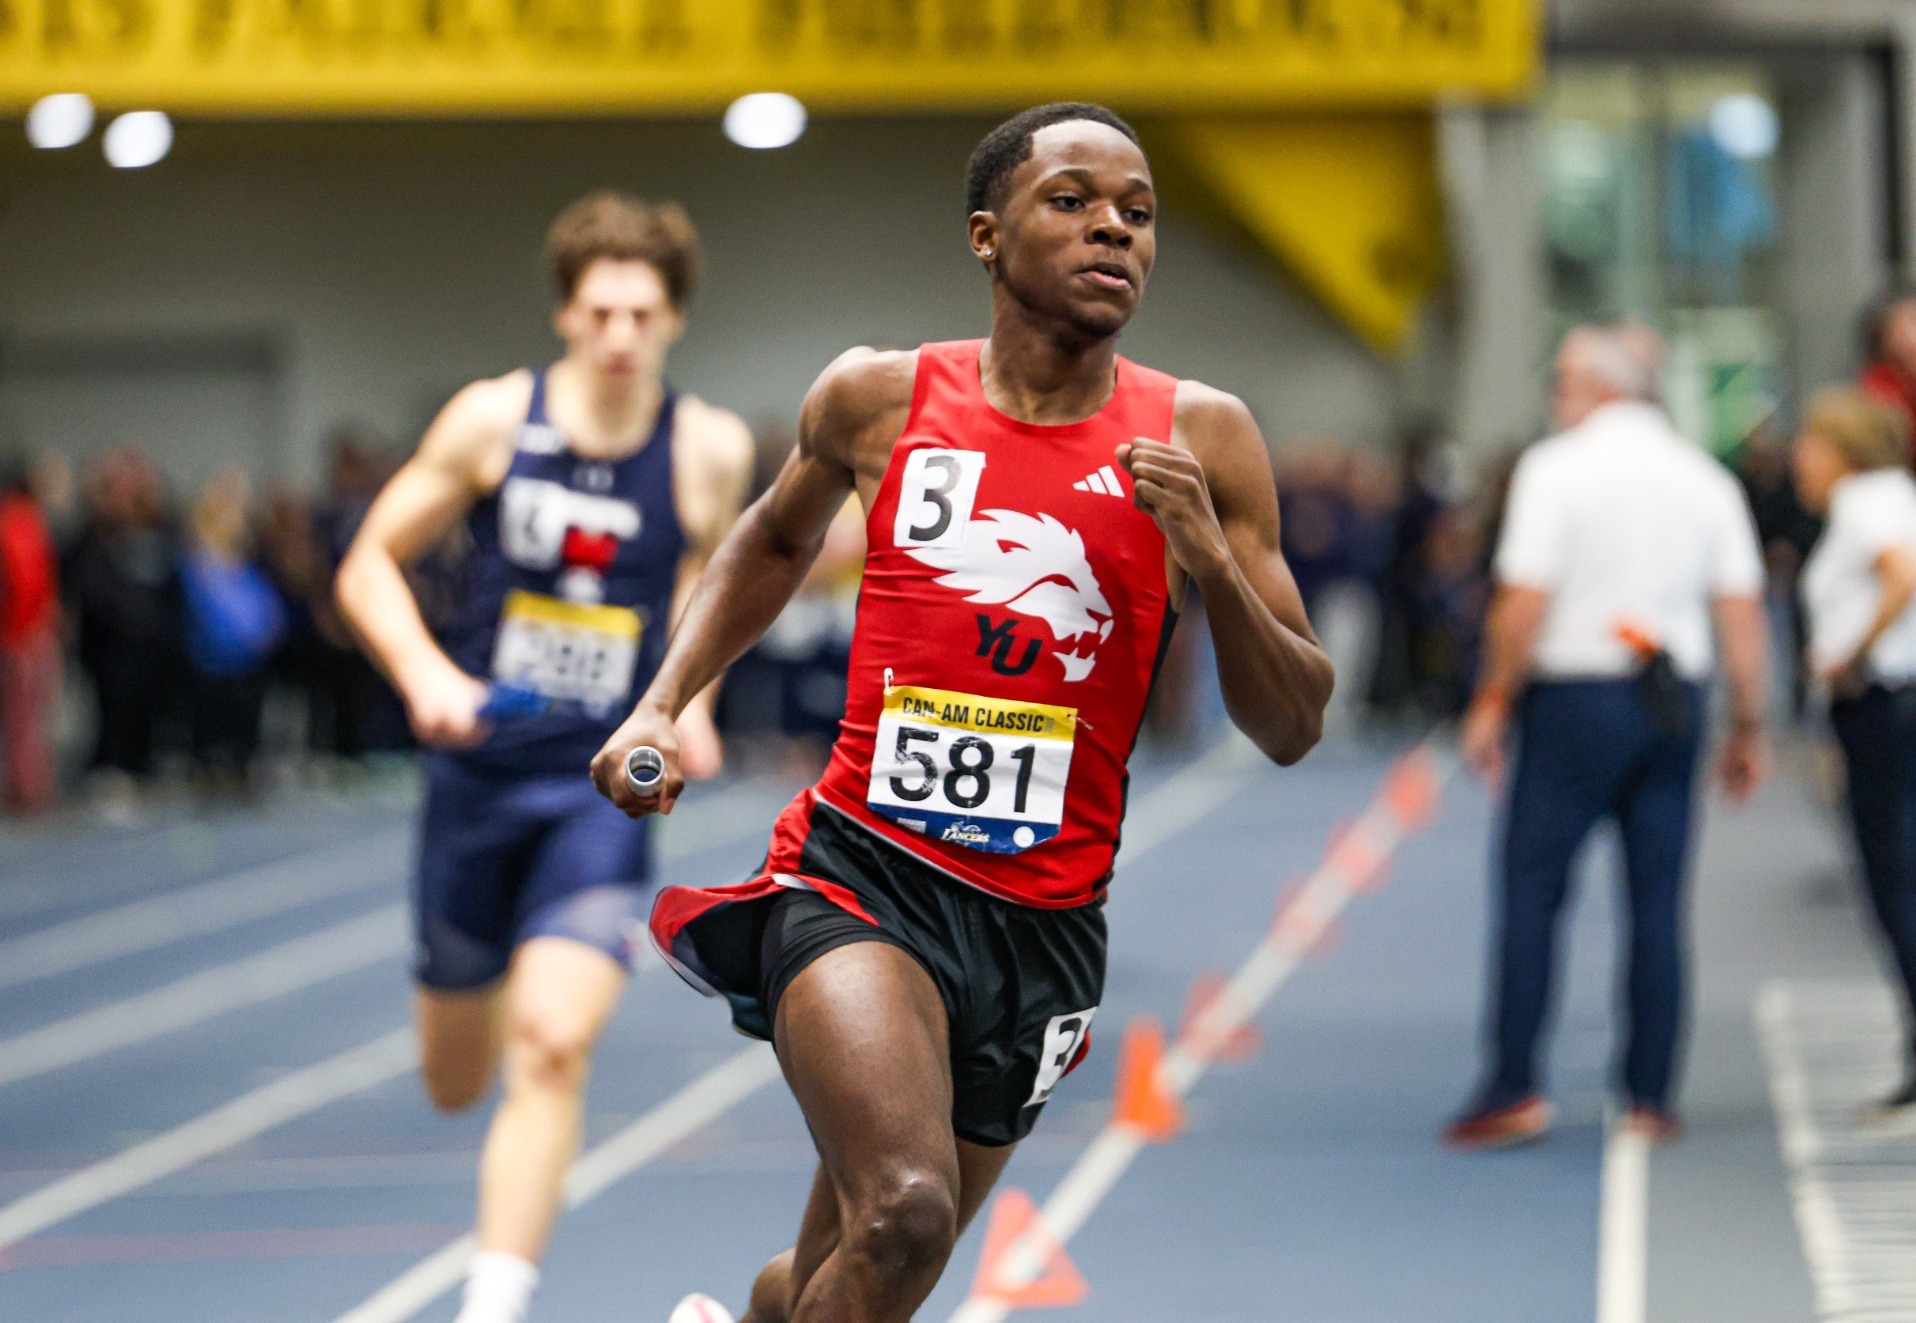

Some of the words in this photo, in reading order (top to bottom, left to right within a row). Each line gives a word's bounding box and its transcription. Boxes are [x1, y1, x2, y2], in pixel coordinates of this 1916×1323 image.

[908, 454, 962, 542] 3
[974, 613, 1043, 677] YU
[902, 697, 969, 724] CAN-AM
[975, 708, 1045, 733] CLASSIC
[889, 726, 1036, 813] 581
